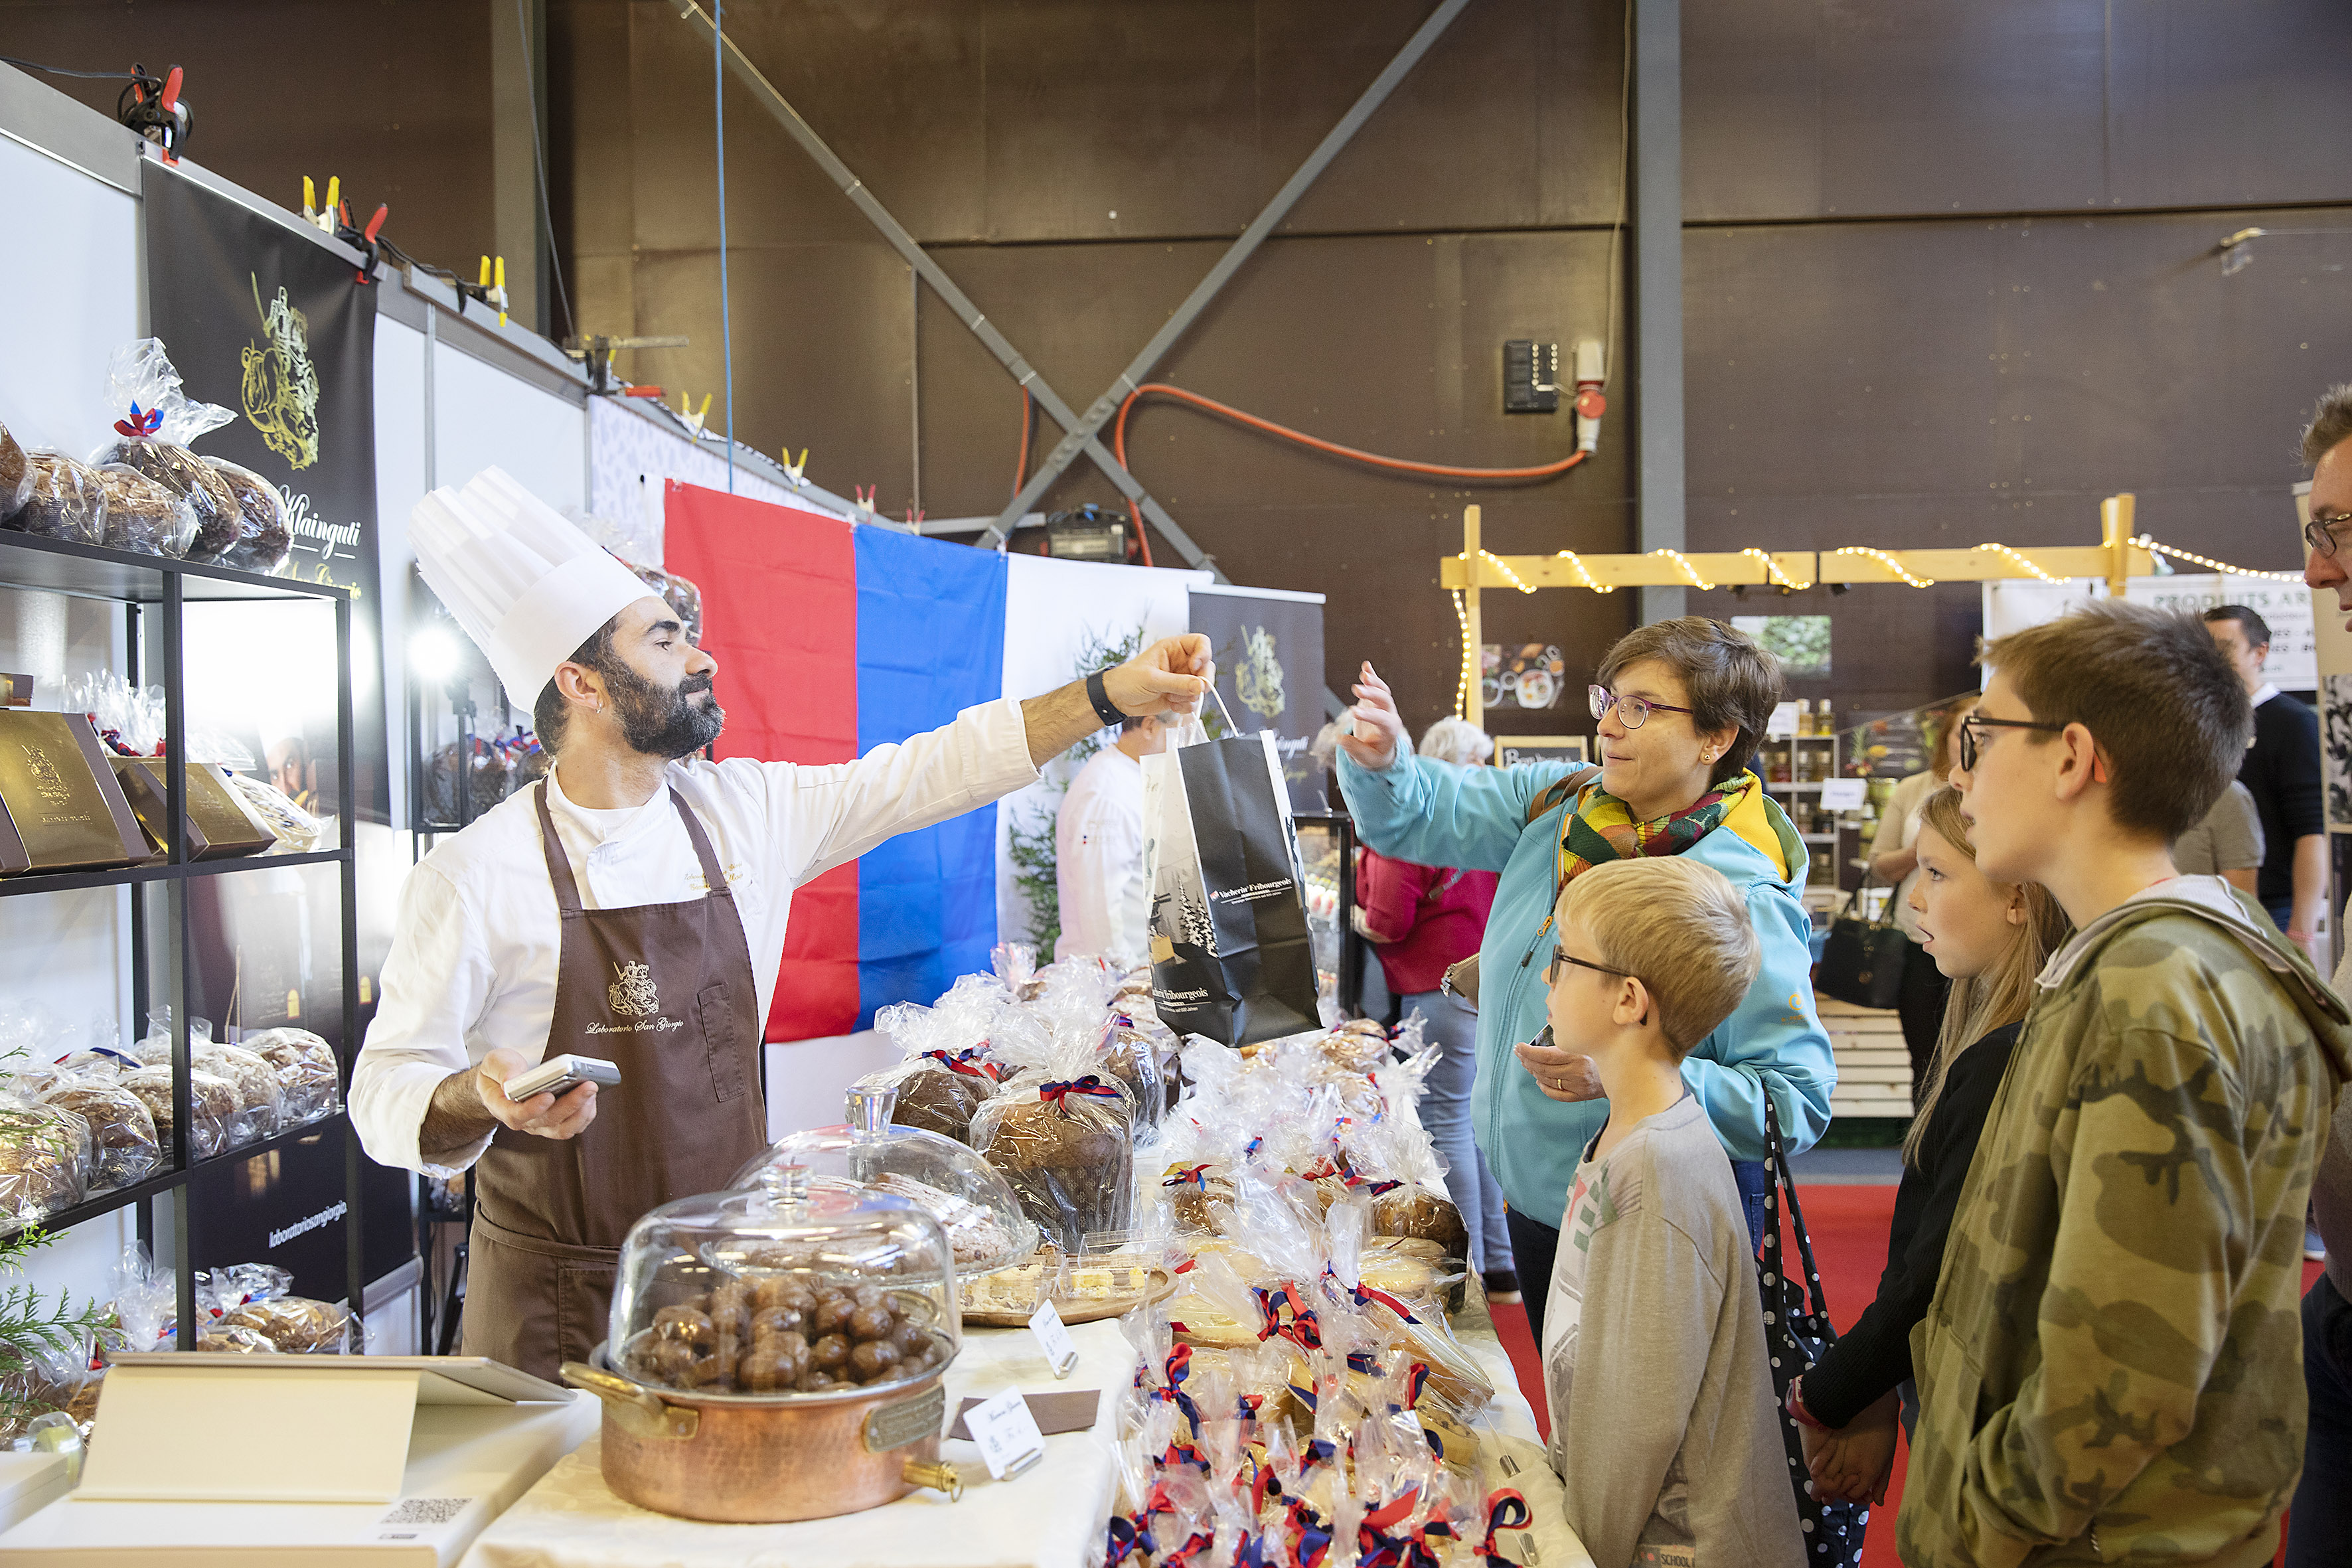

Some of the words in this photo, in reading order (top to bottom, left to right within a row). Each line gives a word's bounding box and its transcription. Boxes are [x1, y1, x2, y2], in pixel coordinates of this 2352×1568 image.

[1248, 877, 1292, 892] Fribourgeois
[585, 1022, 632, 1034] Laboratorio
[635, 1019, 655, 1033] San
[656, 1016, 684, 1032] Giorgio
